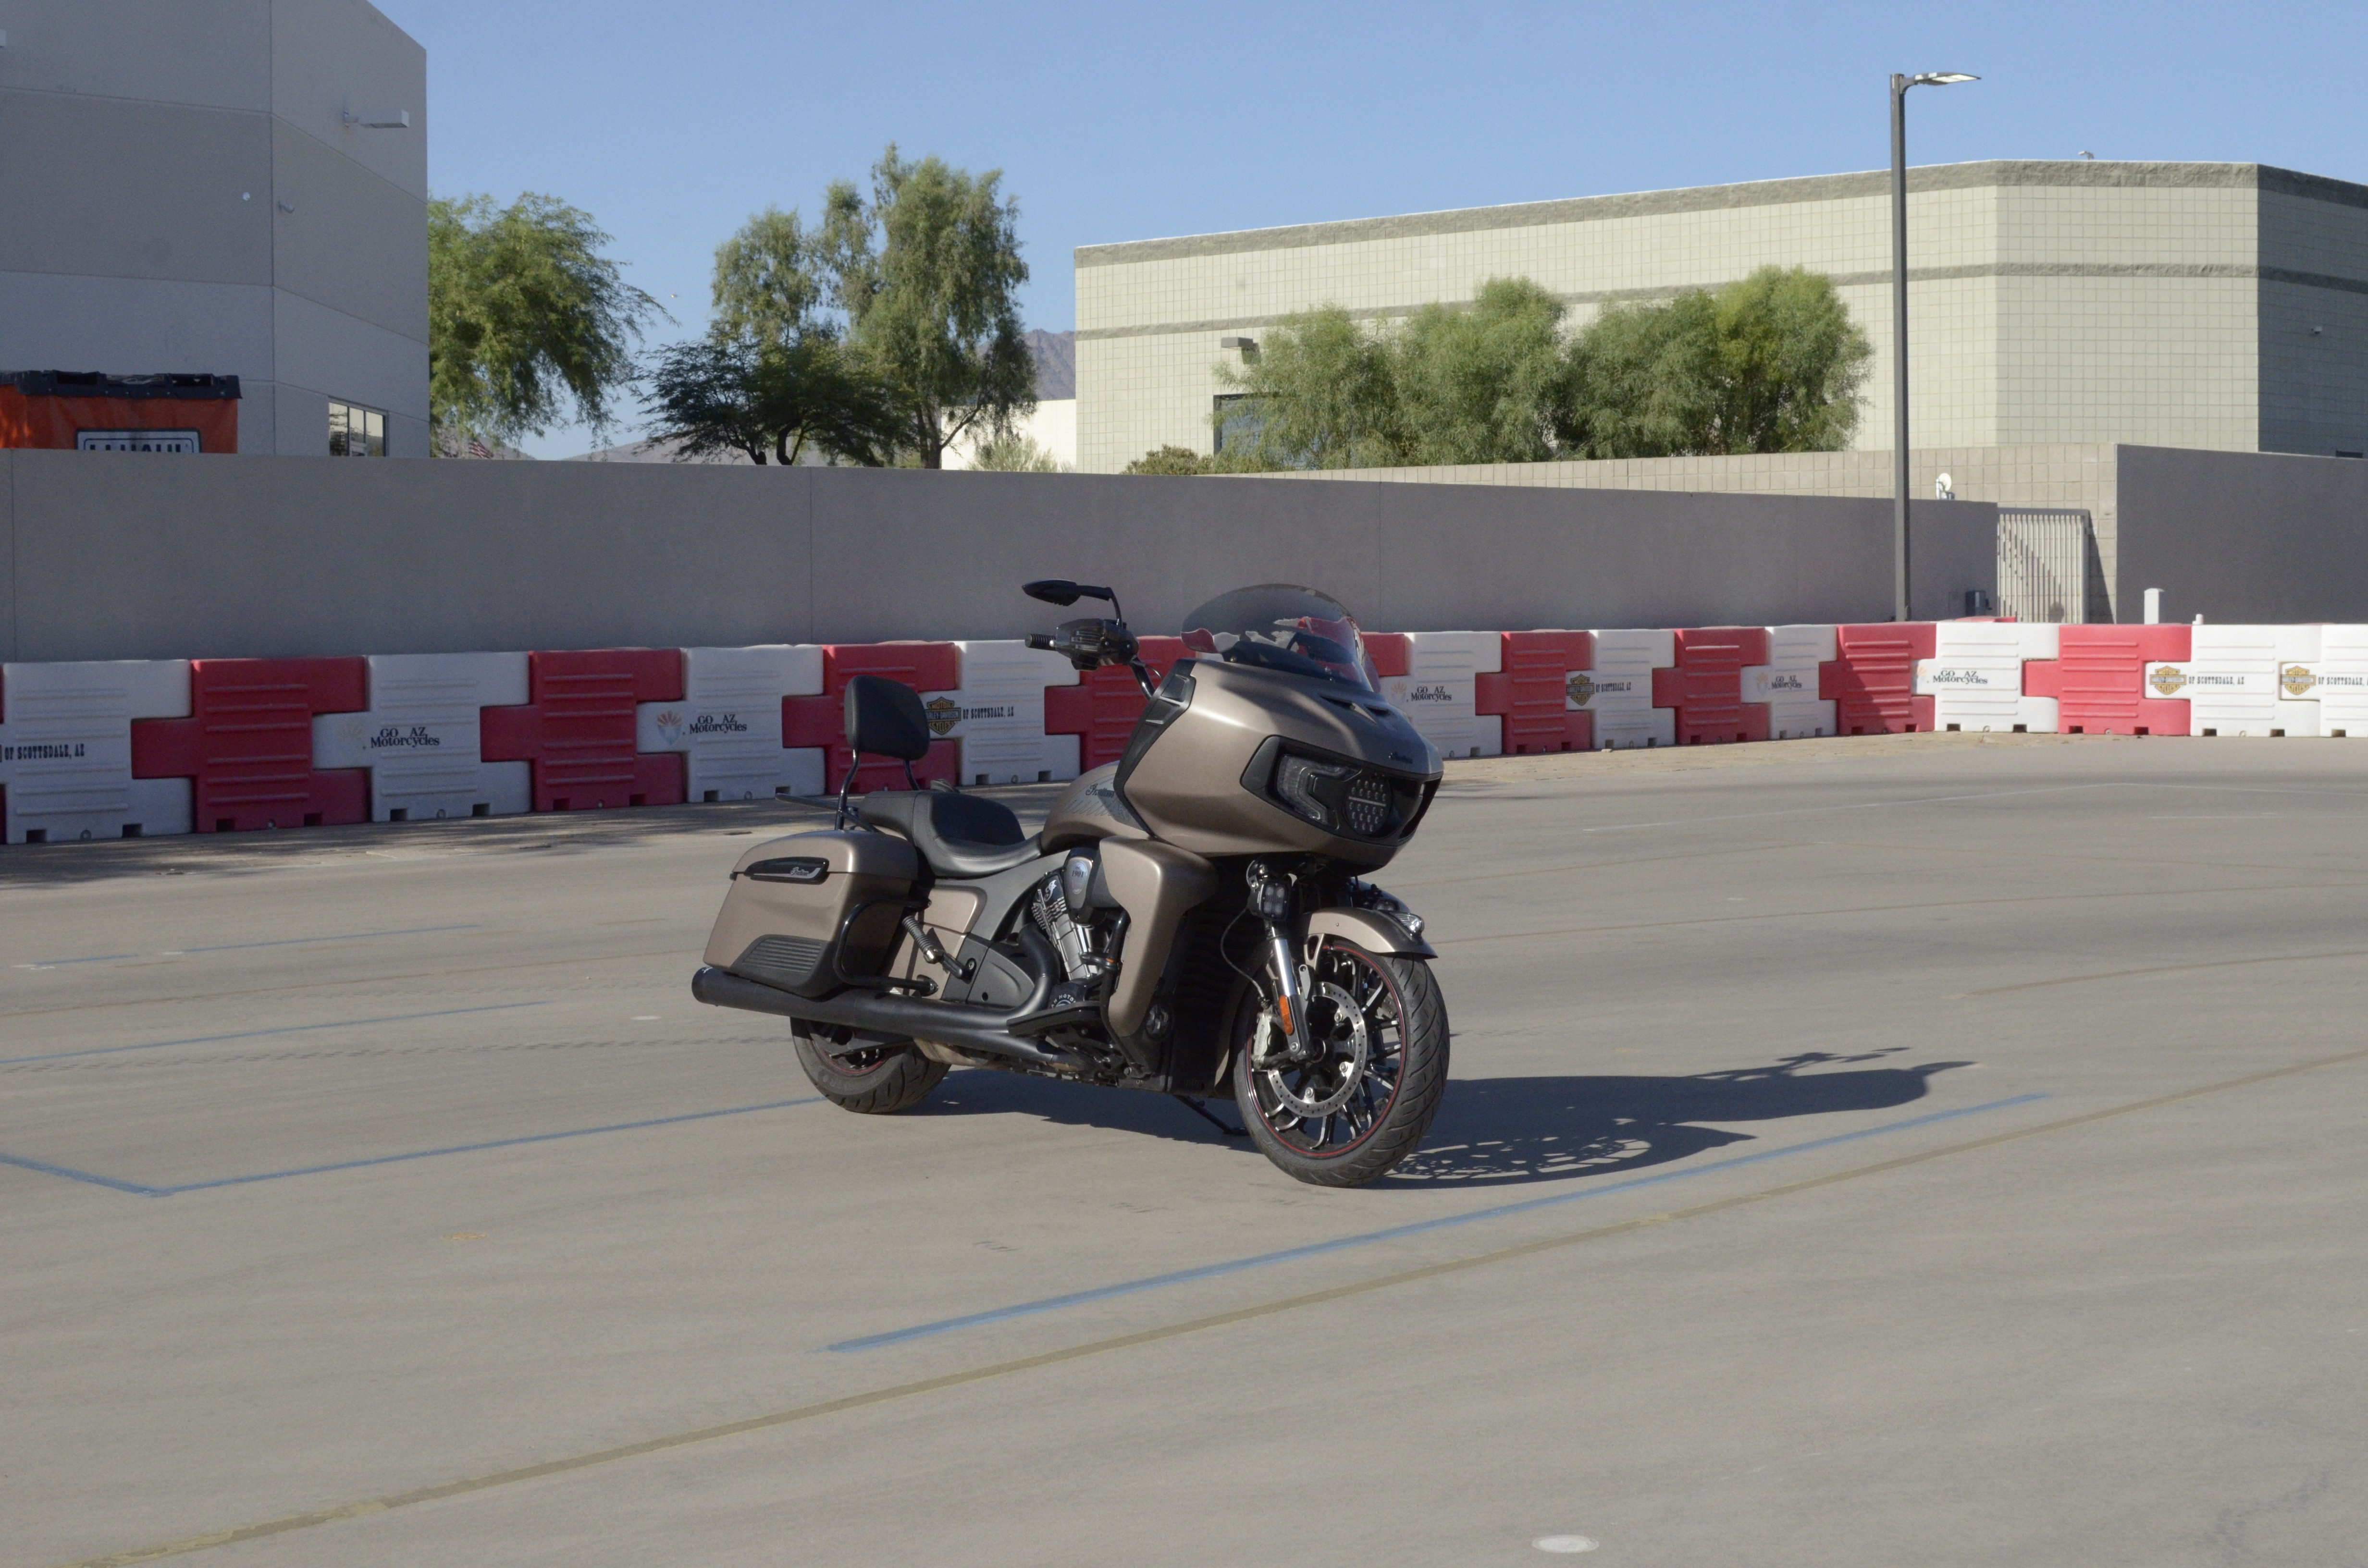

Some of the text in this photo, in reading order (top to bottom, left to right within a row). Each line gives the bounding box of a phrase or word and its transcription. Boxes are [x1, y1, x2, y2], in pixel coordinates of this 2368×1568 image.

[1933, 675, 1988, 685] Motorcycles
[2189, 676, 2195, 685] OF
[2318, 676, 2324, 685] OF
[1411, 692, 1452, 702] Motorcycles
[698, 713, 736, 724] GO AZ
[963, 709, 969, 719] OF
[380, 726, 425, 737] GO AZ
[689, 721, 747, 735] Motorcycles
[370, 734, 440, 748] Motorcycles
[5, 743, 84, 760] OF SCOTTSDALE, AZ
[1059, 993, 1076, 1003] MOTO
